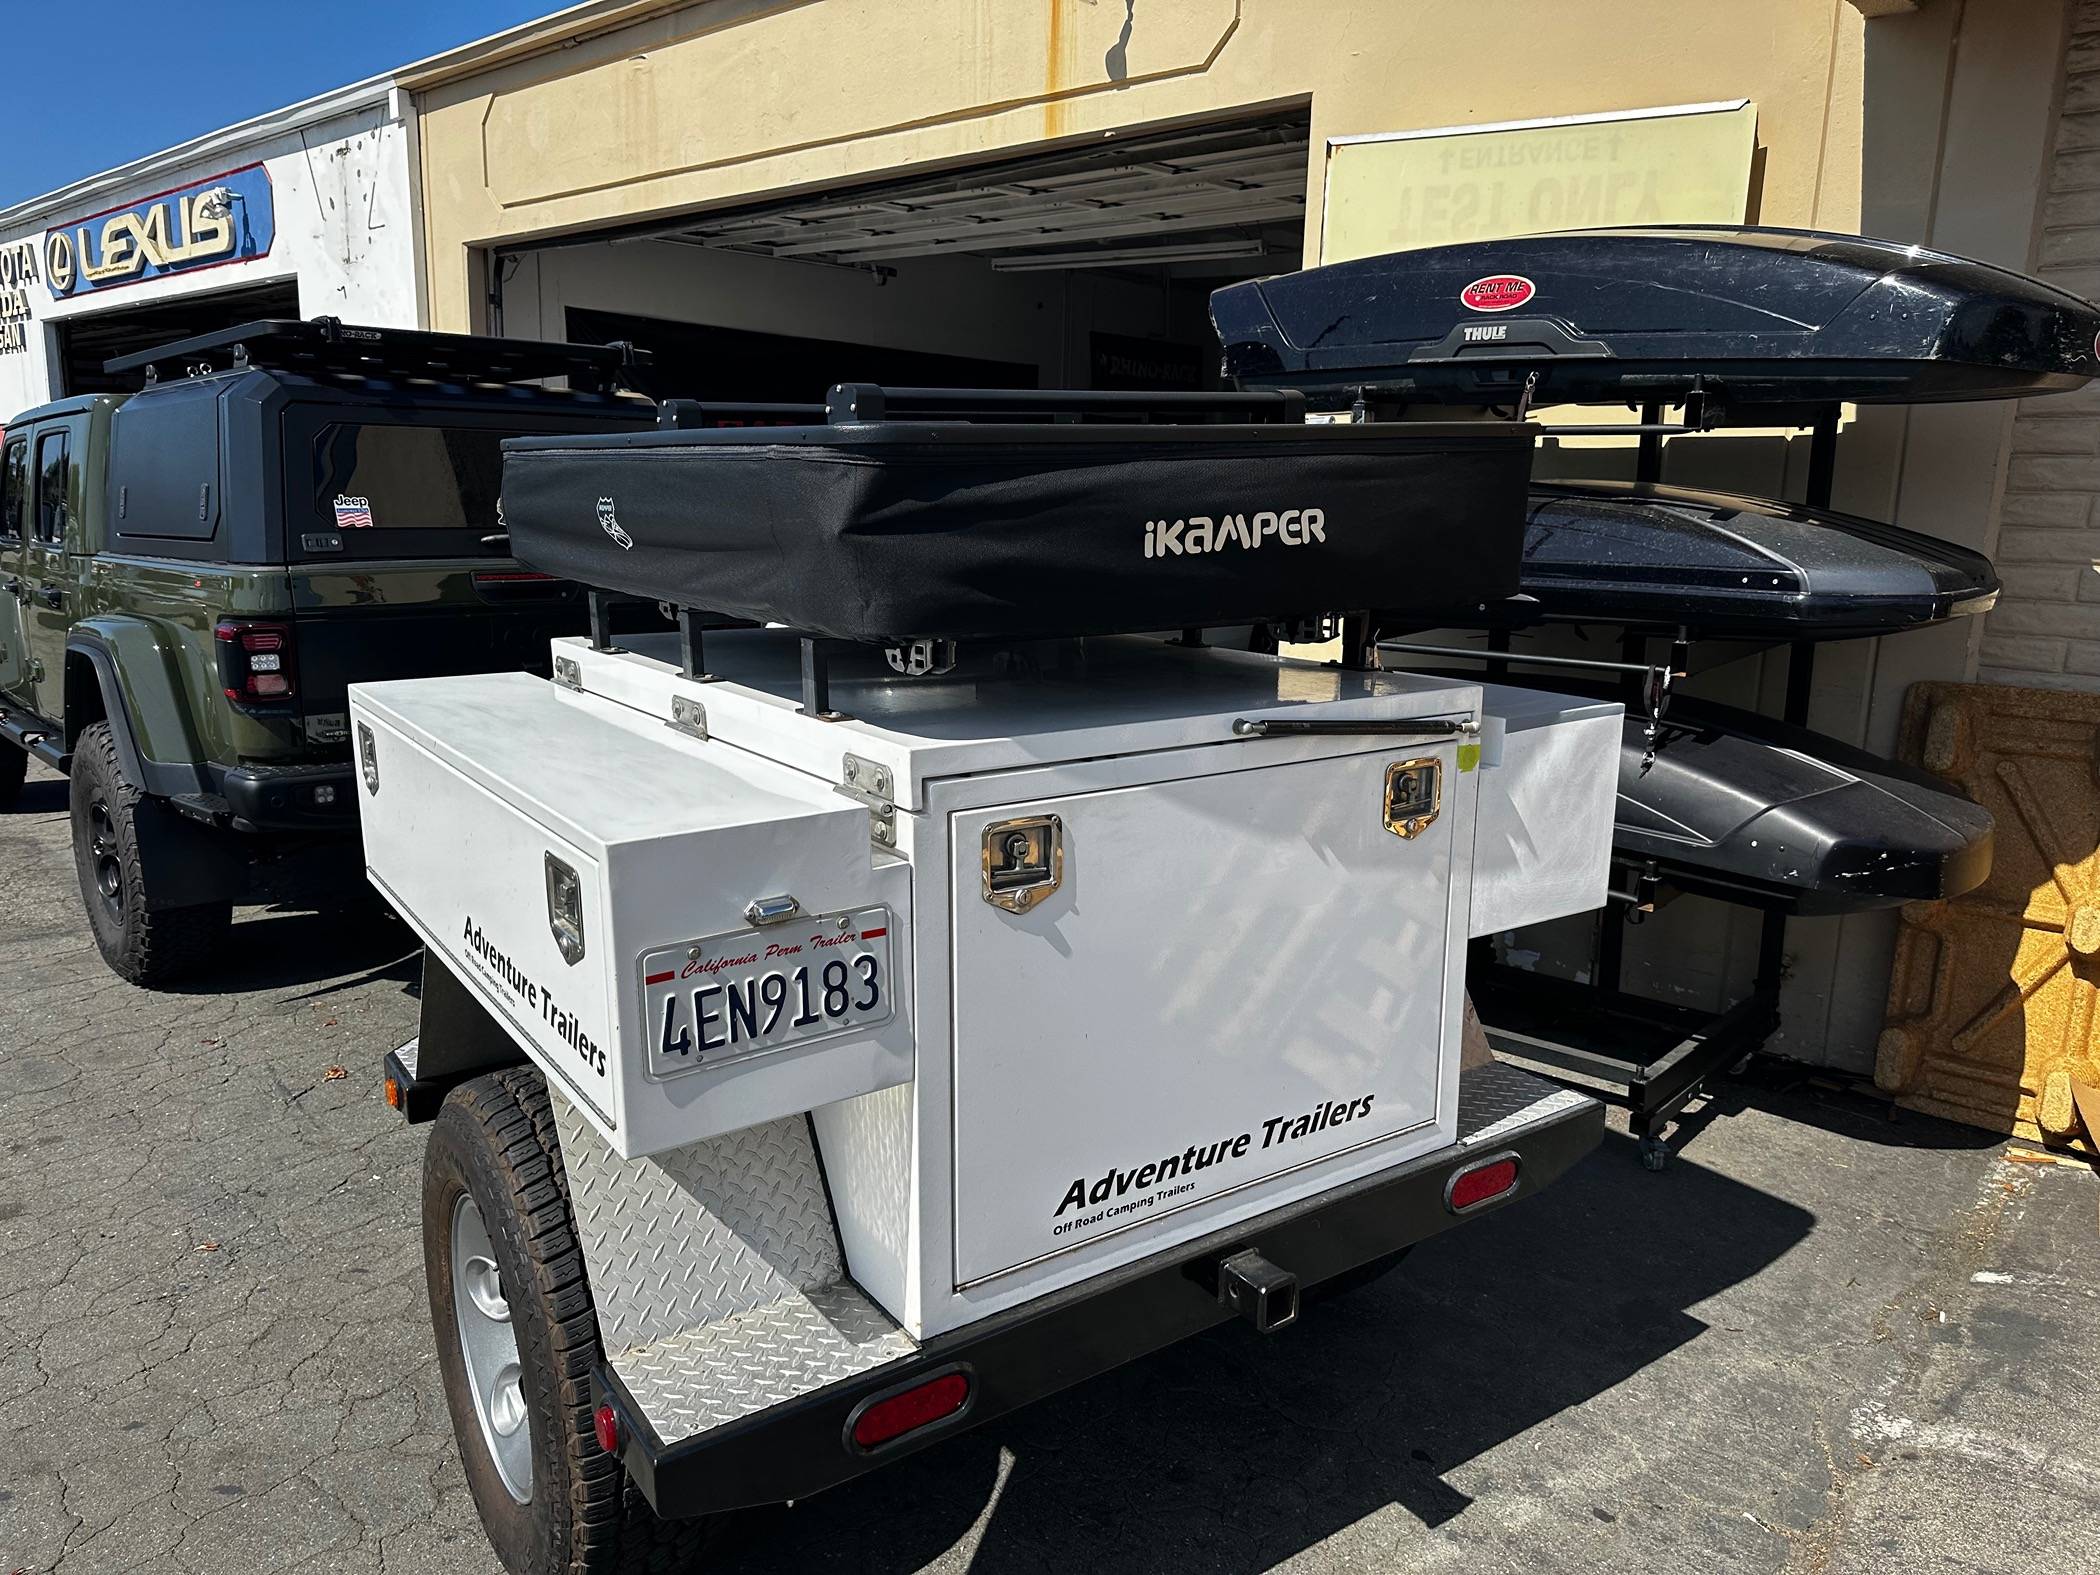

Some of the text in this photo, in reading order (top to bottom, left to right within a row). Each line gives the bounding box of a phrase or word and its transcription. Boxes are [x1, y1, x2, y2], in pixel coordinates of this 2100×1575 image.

[78, 187, 235, 281] LEXUS
[1470, 281, 1526, 295] RENT ME
[1463, 325, 1507, 341] THULE
[335, 494, 368, 508] Jeep
[680, 931, 857, 980] California Perm Trailer
[463, 915, 607, 1078] Adventure Trailers
[661, 953, 881, 1056] 4EN9183
[1052, 1093, 1375, 1218] Adventure Trailers
[1053, 1181, 1196, 1236] Off Road Camping Trailers
